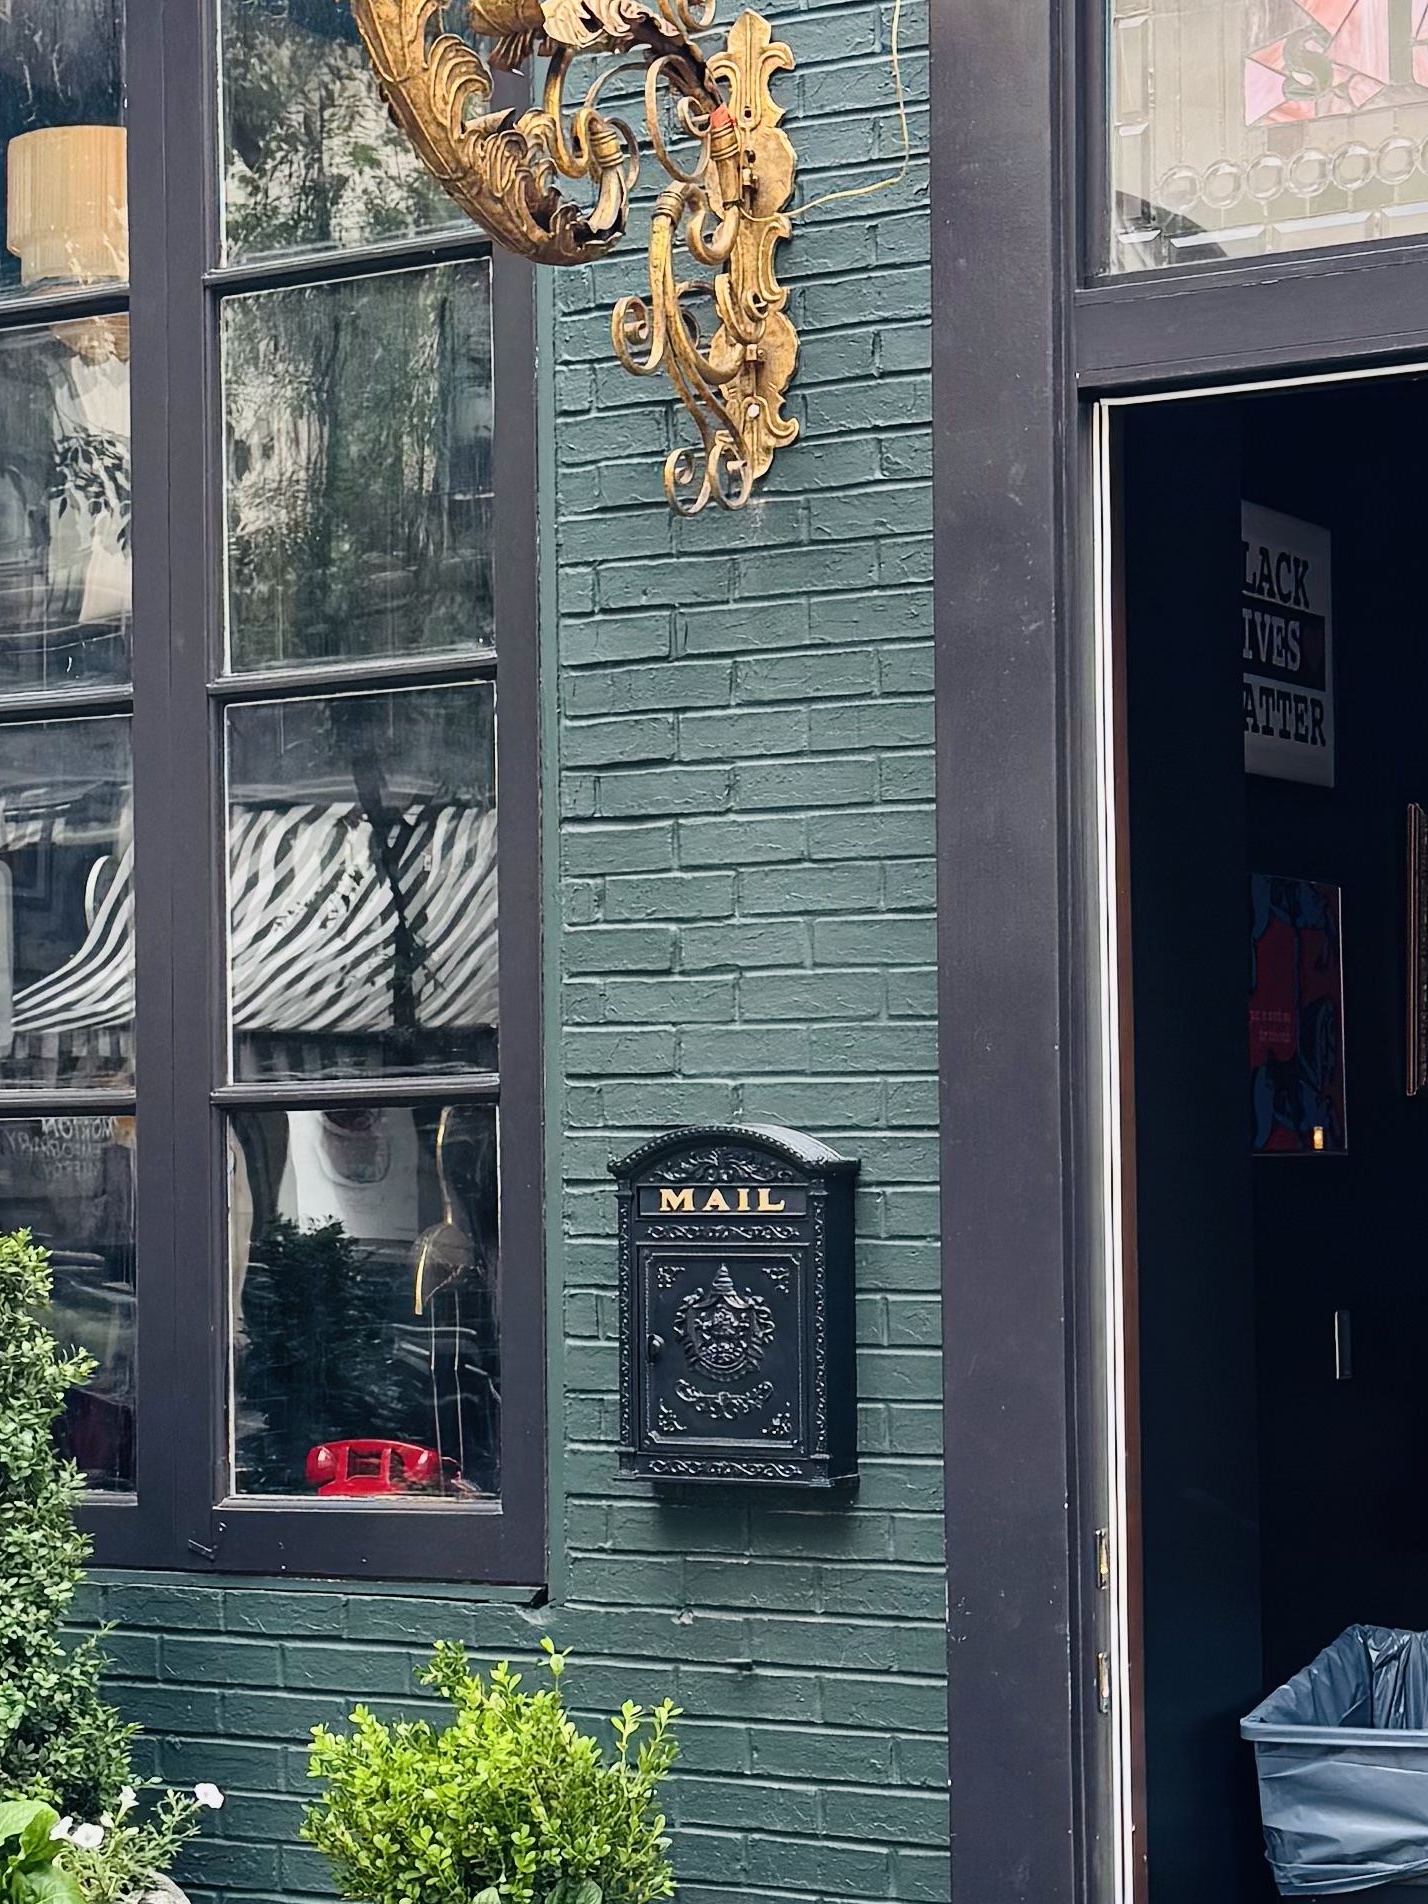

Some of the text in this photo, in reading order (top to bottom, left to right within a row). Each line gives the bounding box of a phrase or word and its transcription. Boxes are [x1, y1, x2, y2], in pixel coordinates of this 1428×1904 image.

[1241, 540, 1311, 610] LACK
[1242, 607, 1302, 672] IVES
[1242, 682, 1327, 748] ATTER
[658, 1187, 787, 1214] MAIL
